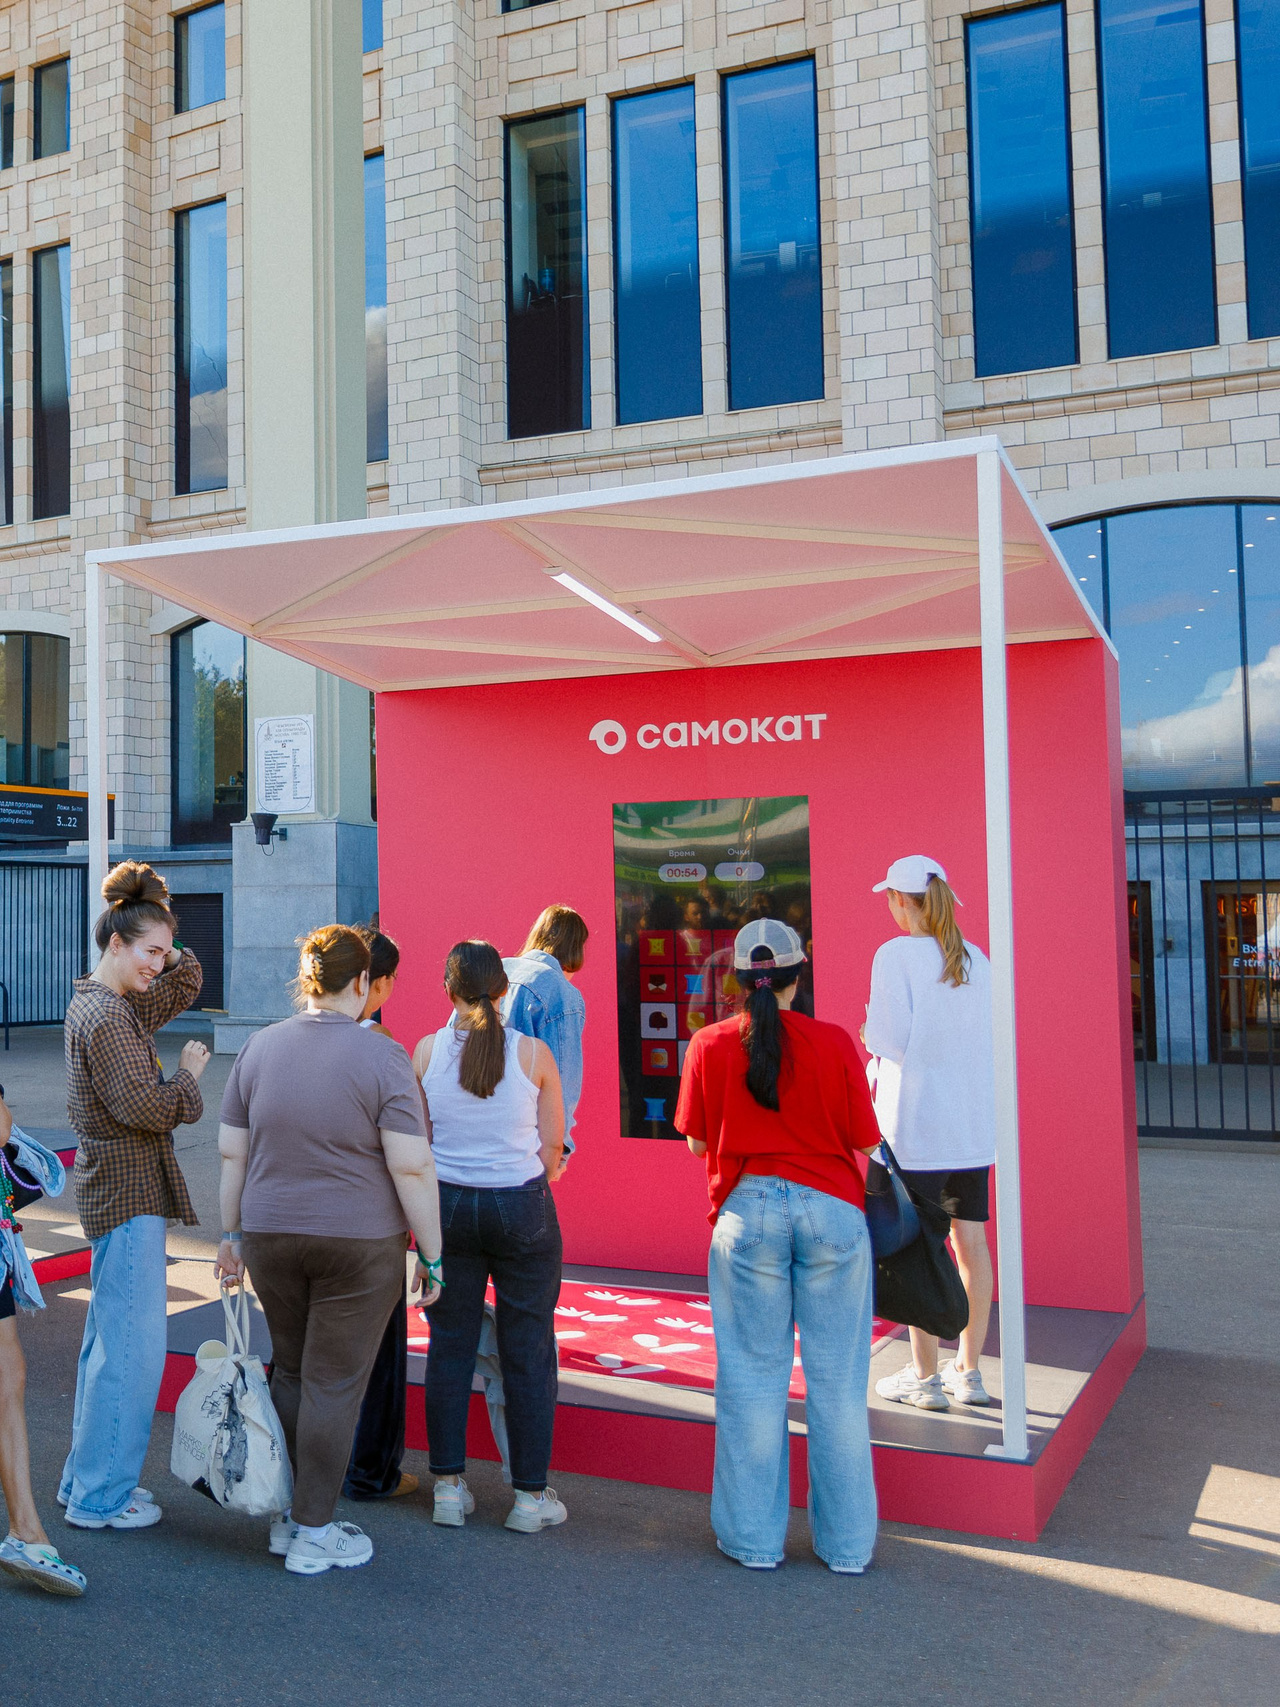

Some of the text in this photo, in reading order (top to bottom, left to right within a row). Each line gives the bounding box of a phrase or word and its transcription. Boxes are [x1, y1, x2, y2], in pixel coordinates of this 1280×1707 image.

[636, 713, 828, 750] самокат
[668, 849, 696, 858] Время
[727, 848, 750, 857] Очки
[666, 868, 699, 878] 00:54
[735, 867, 743, 877] 0
[335, 1537, 348, 1552] N
